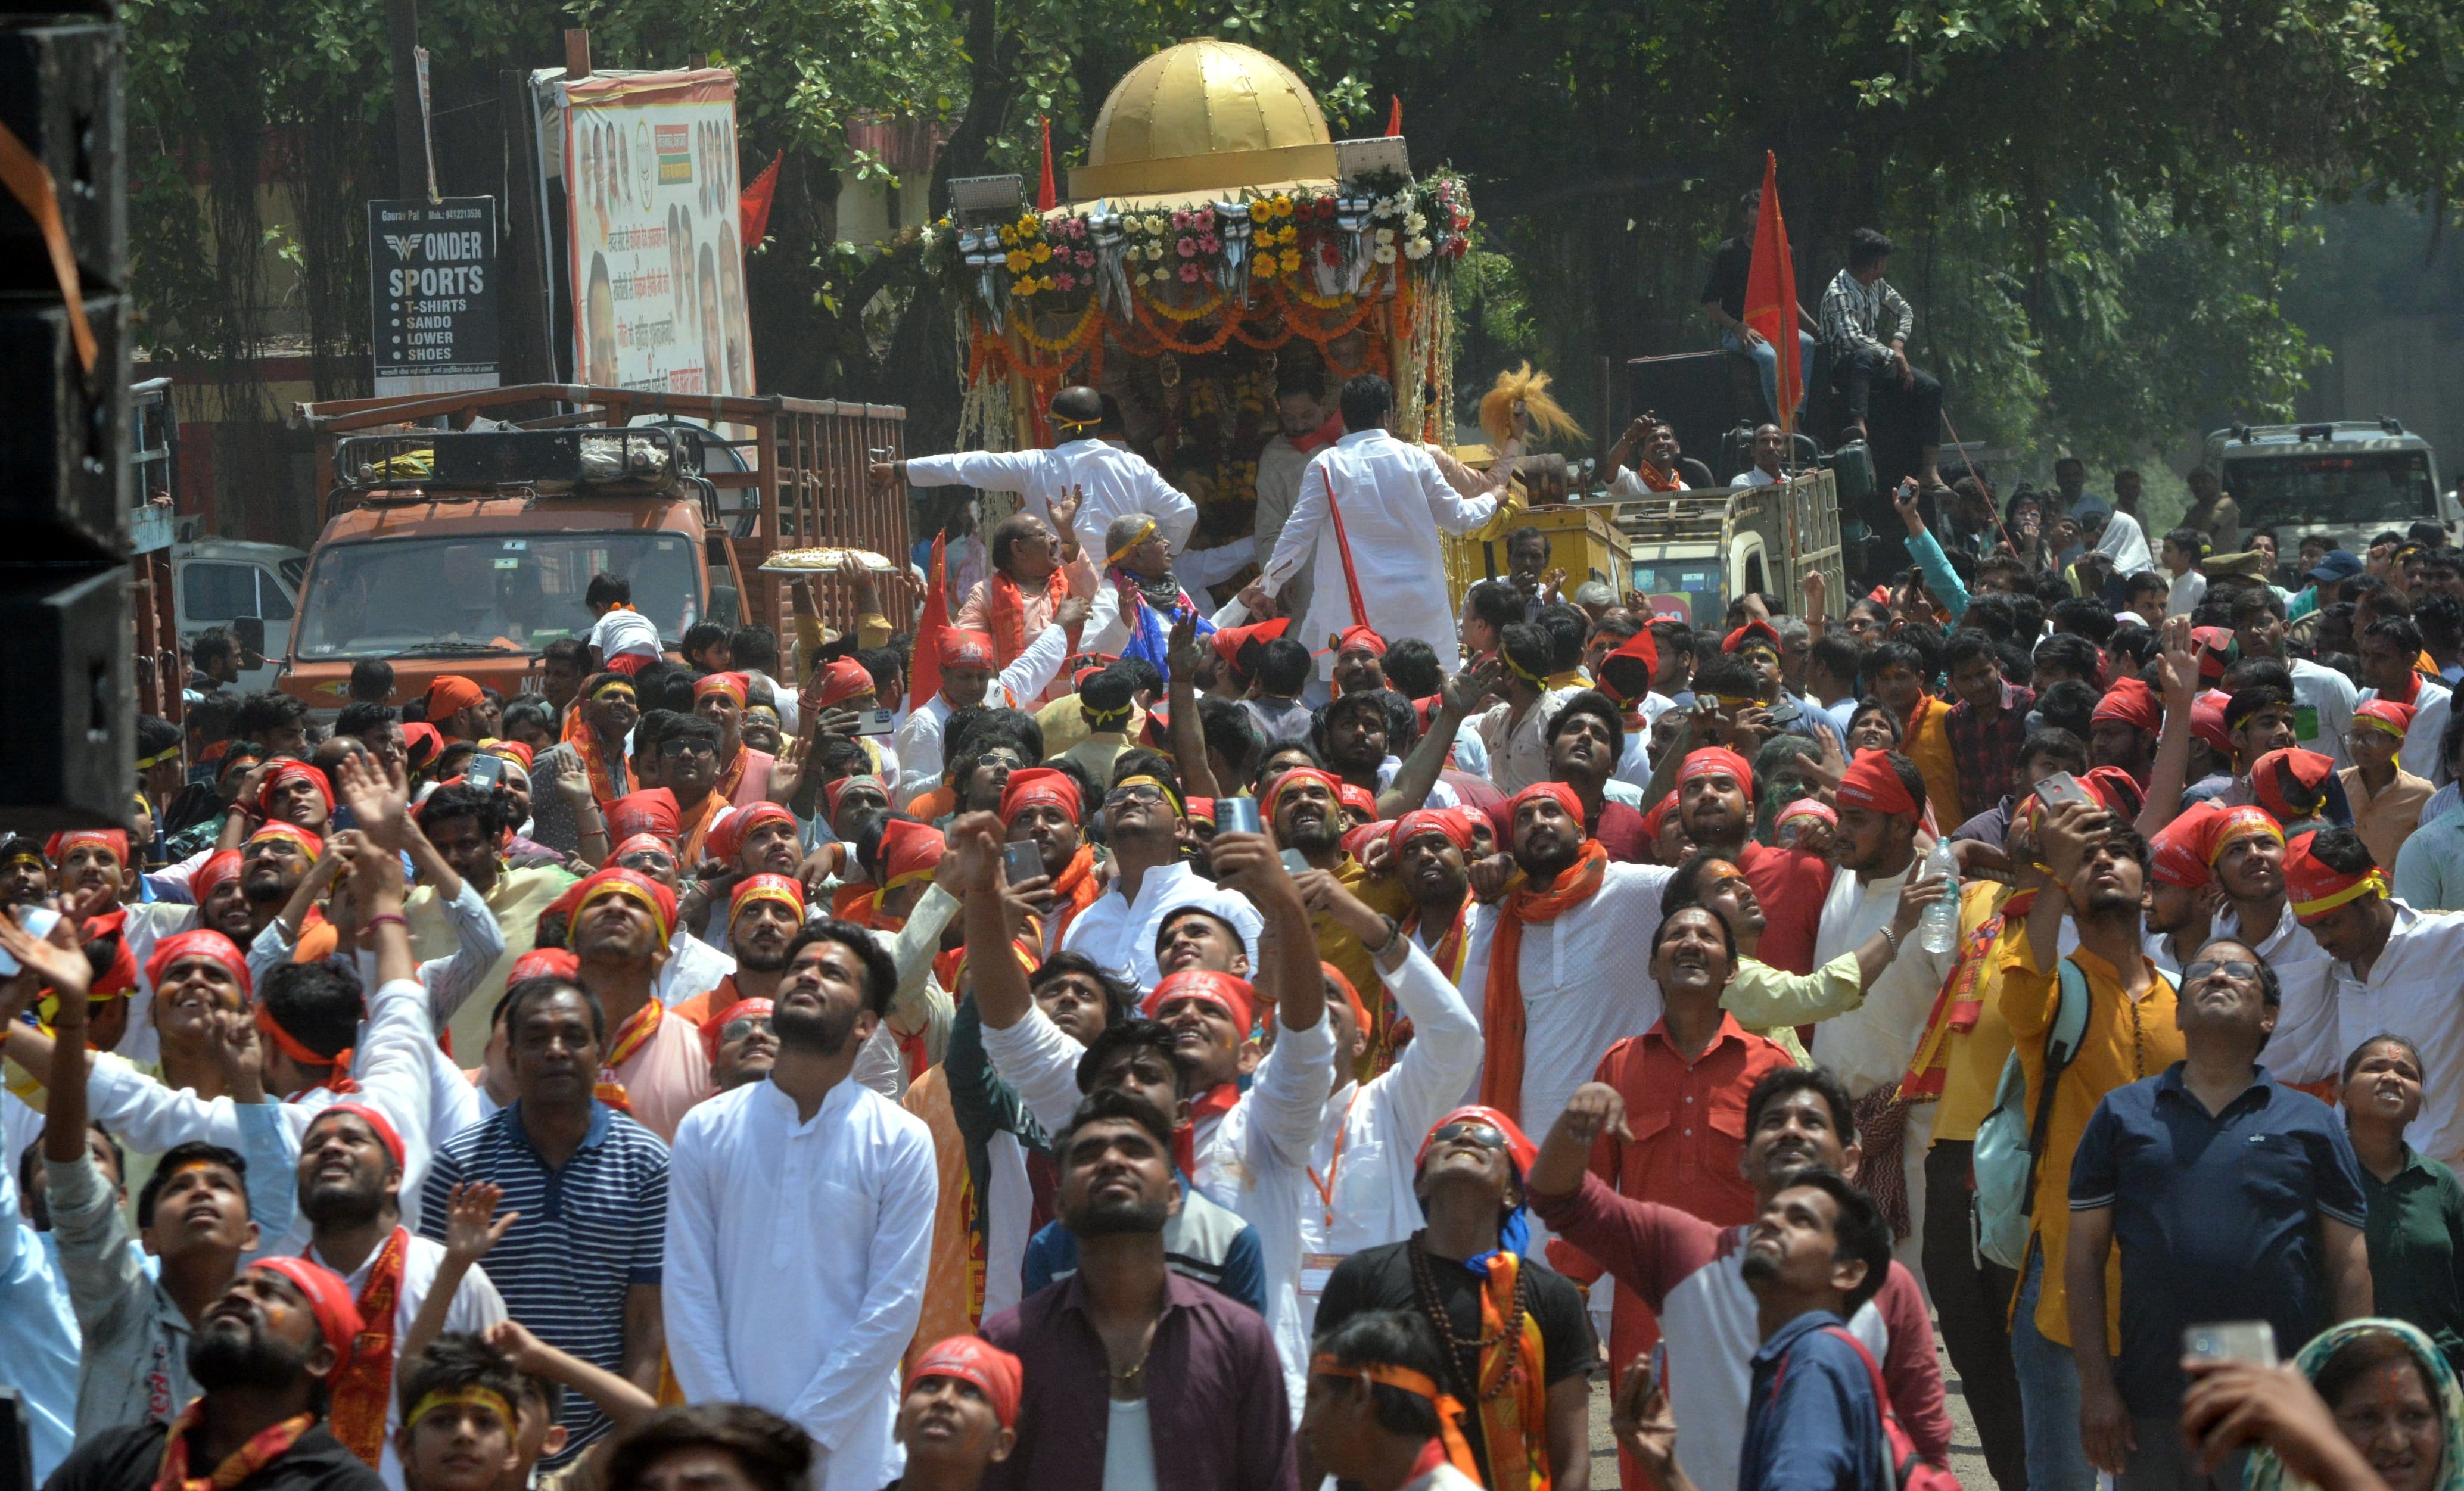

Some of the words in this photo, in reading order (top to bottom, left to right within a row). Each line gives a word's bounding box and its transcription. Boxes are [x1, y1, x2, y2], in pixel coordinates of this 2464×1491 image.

[389, 265, 484, 298] SPORTS
[405, 299, 467, 313] T-SHIRTS
[407, 316, 452, 329] SANDO
[407, 332, 453, 345] LOWER
[408, 347, 452, 361] SHOES
